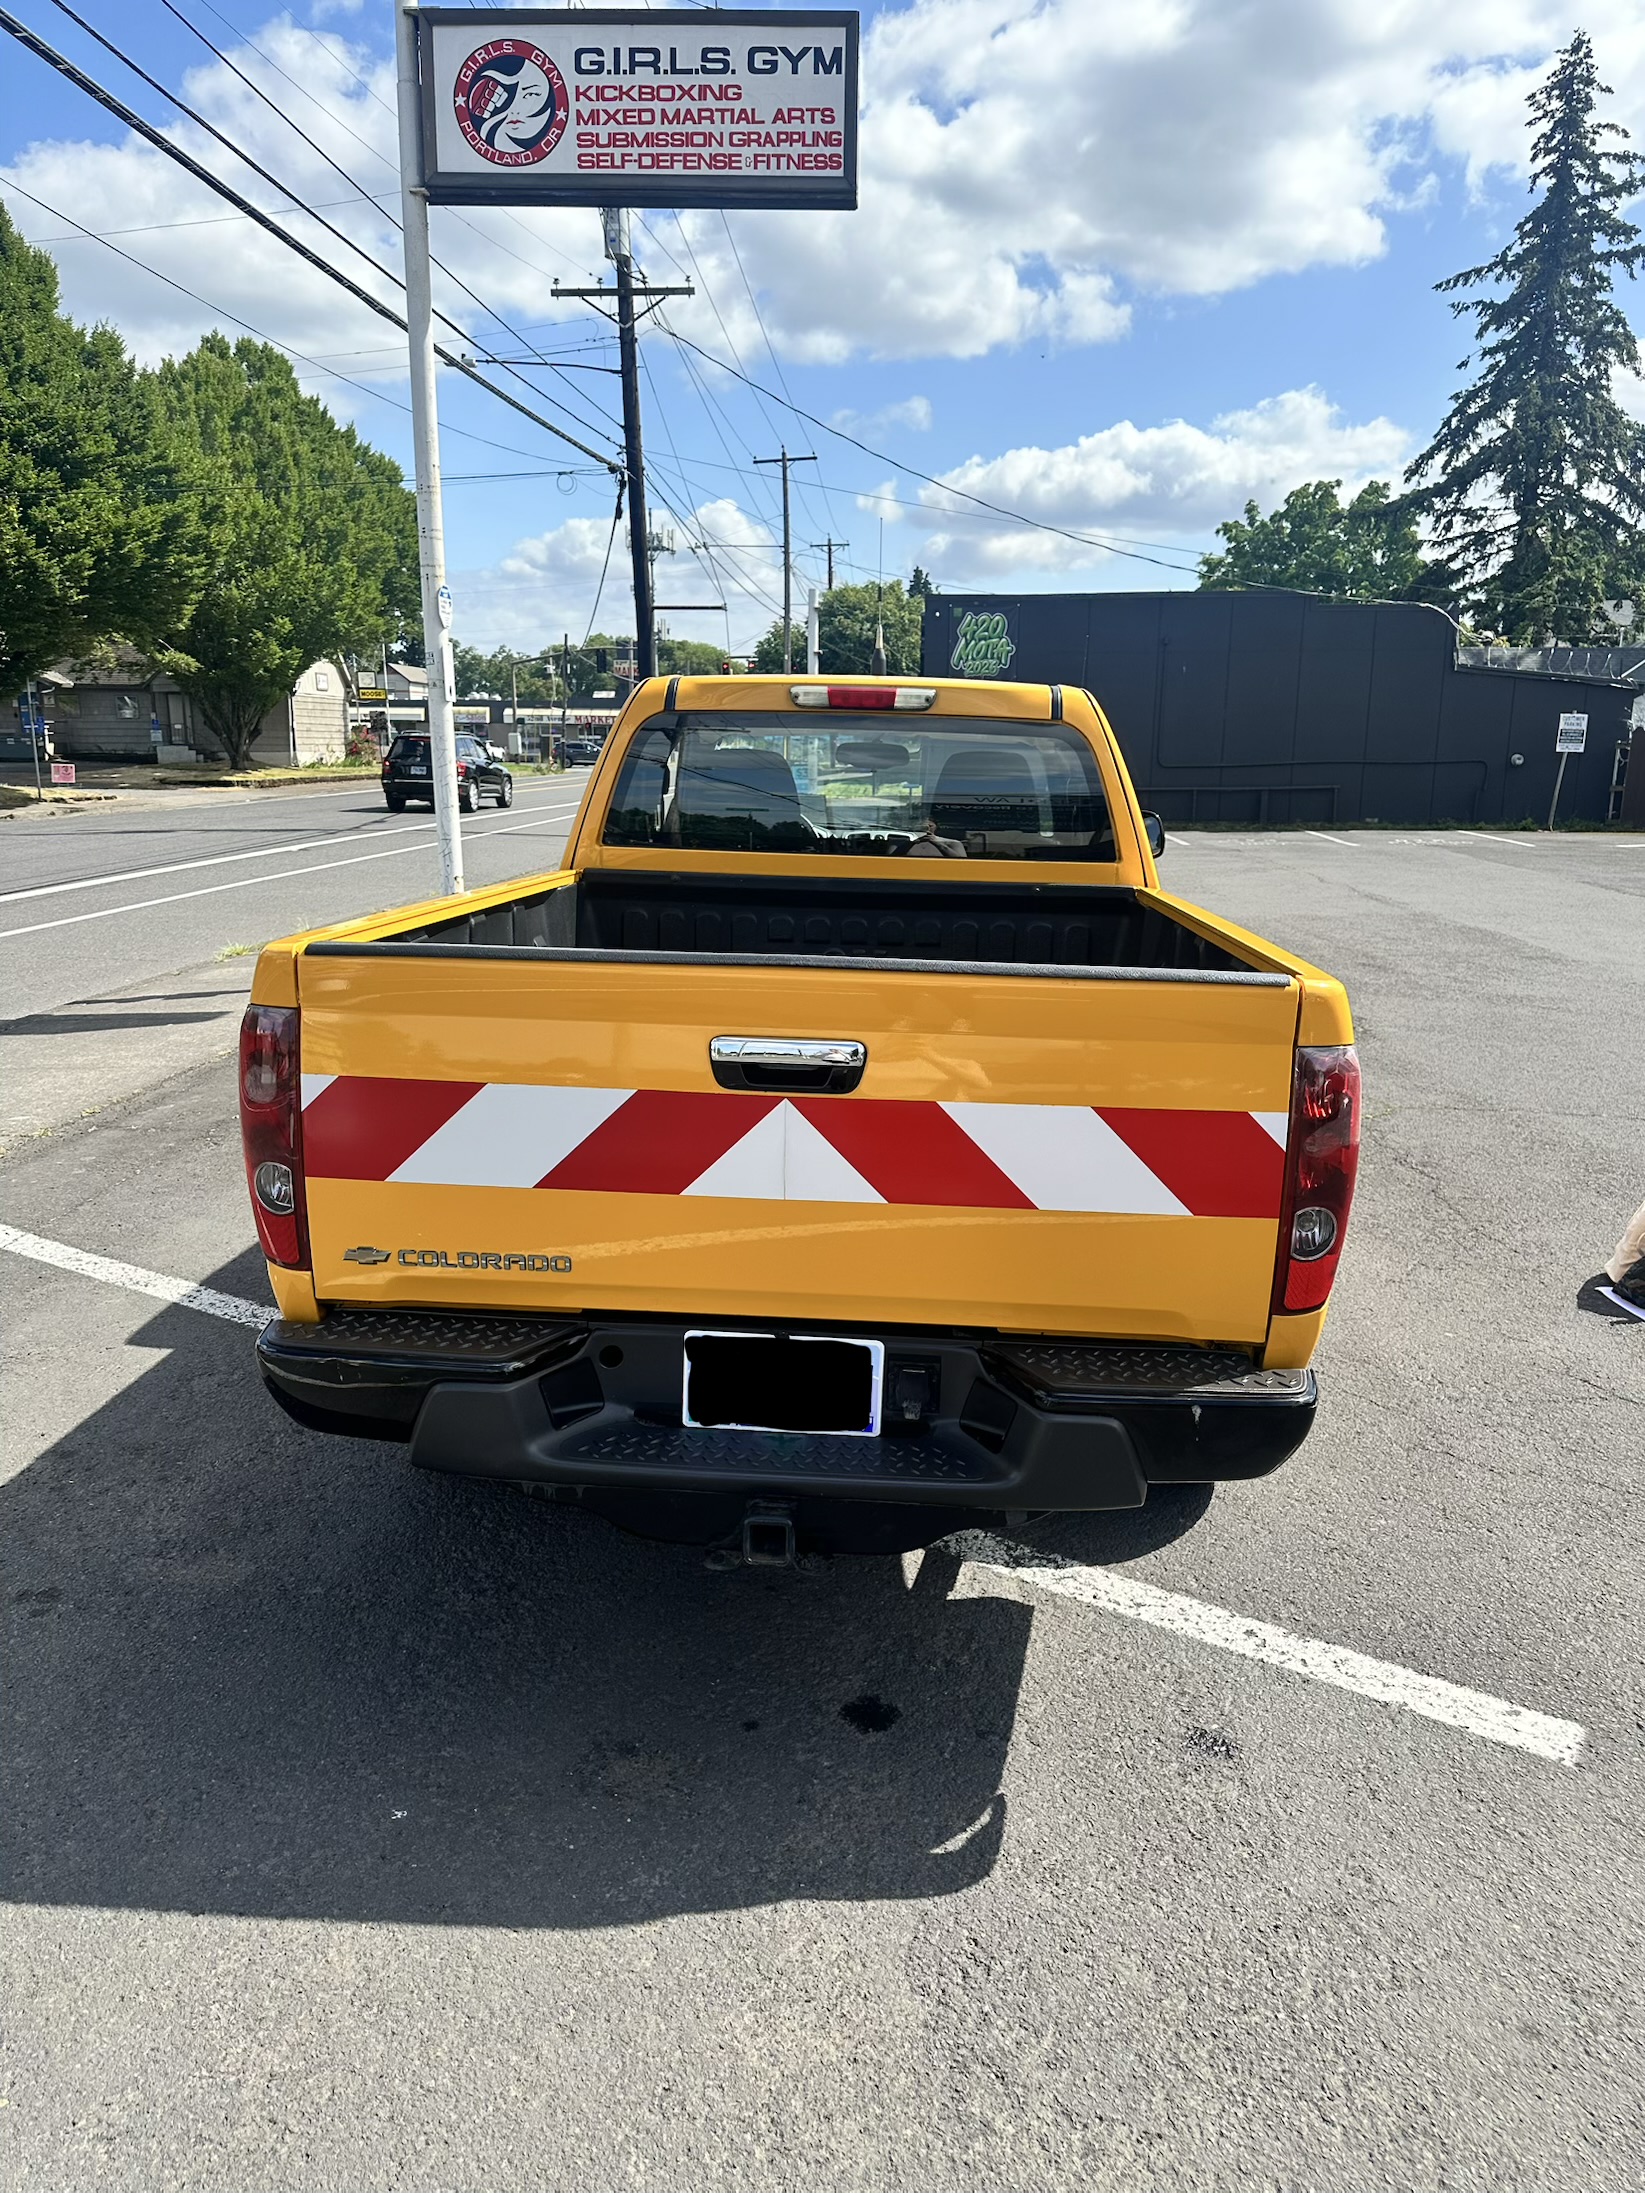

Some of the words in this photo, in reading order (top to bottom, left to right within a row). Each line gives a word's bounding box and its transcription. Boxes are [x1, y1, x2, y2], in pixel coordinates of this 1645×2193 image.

[461, 41, 515, 82] G.I.R.L.S.
[531, 50, 562, 88] GYM
[574, 47, 736, 75] G.I.R.L.S.
[747, 46, 843, 75] GYM
[575, 84, 742, 102] KICKBOXING
[576, 108, 656, 126] MIXED
[660, 107, 765, 125] MARTIAL
[771, 107, 836, 125] ARTS
[460, 120, 537, 165] PORTLAND,
[541, 127, 562, 152] OR
[576, 131, 724, 148] SUBMISSION
[728, 130, 843, 148] GRAPPLING
[577, 152, 742, 170] SELF-DEFENSE
[745, 155, 753, 168] &
[753, 152, 843, 171] FITNESS
[959, 613, 1006, 641] 420
[952, 636, 1014, 667] MOTA
[964, 660, 999, 676] 2026
[398, 1249, 572, 1273] COLORADO
